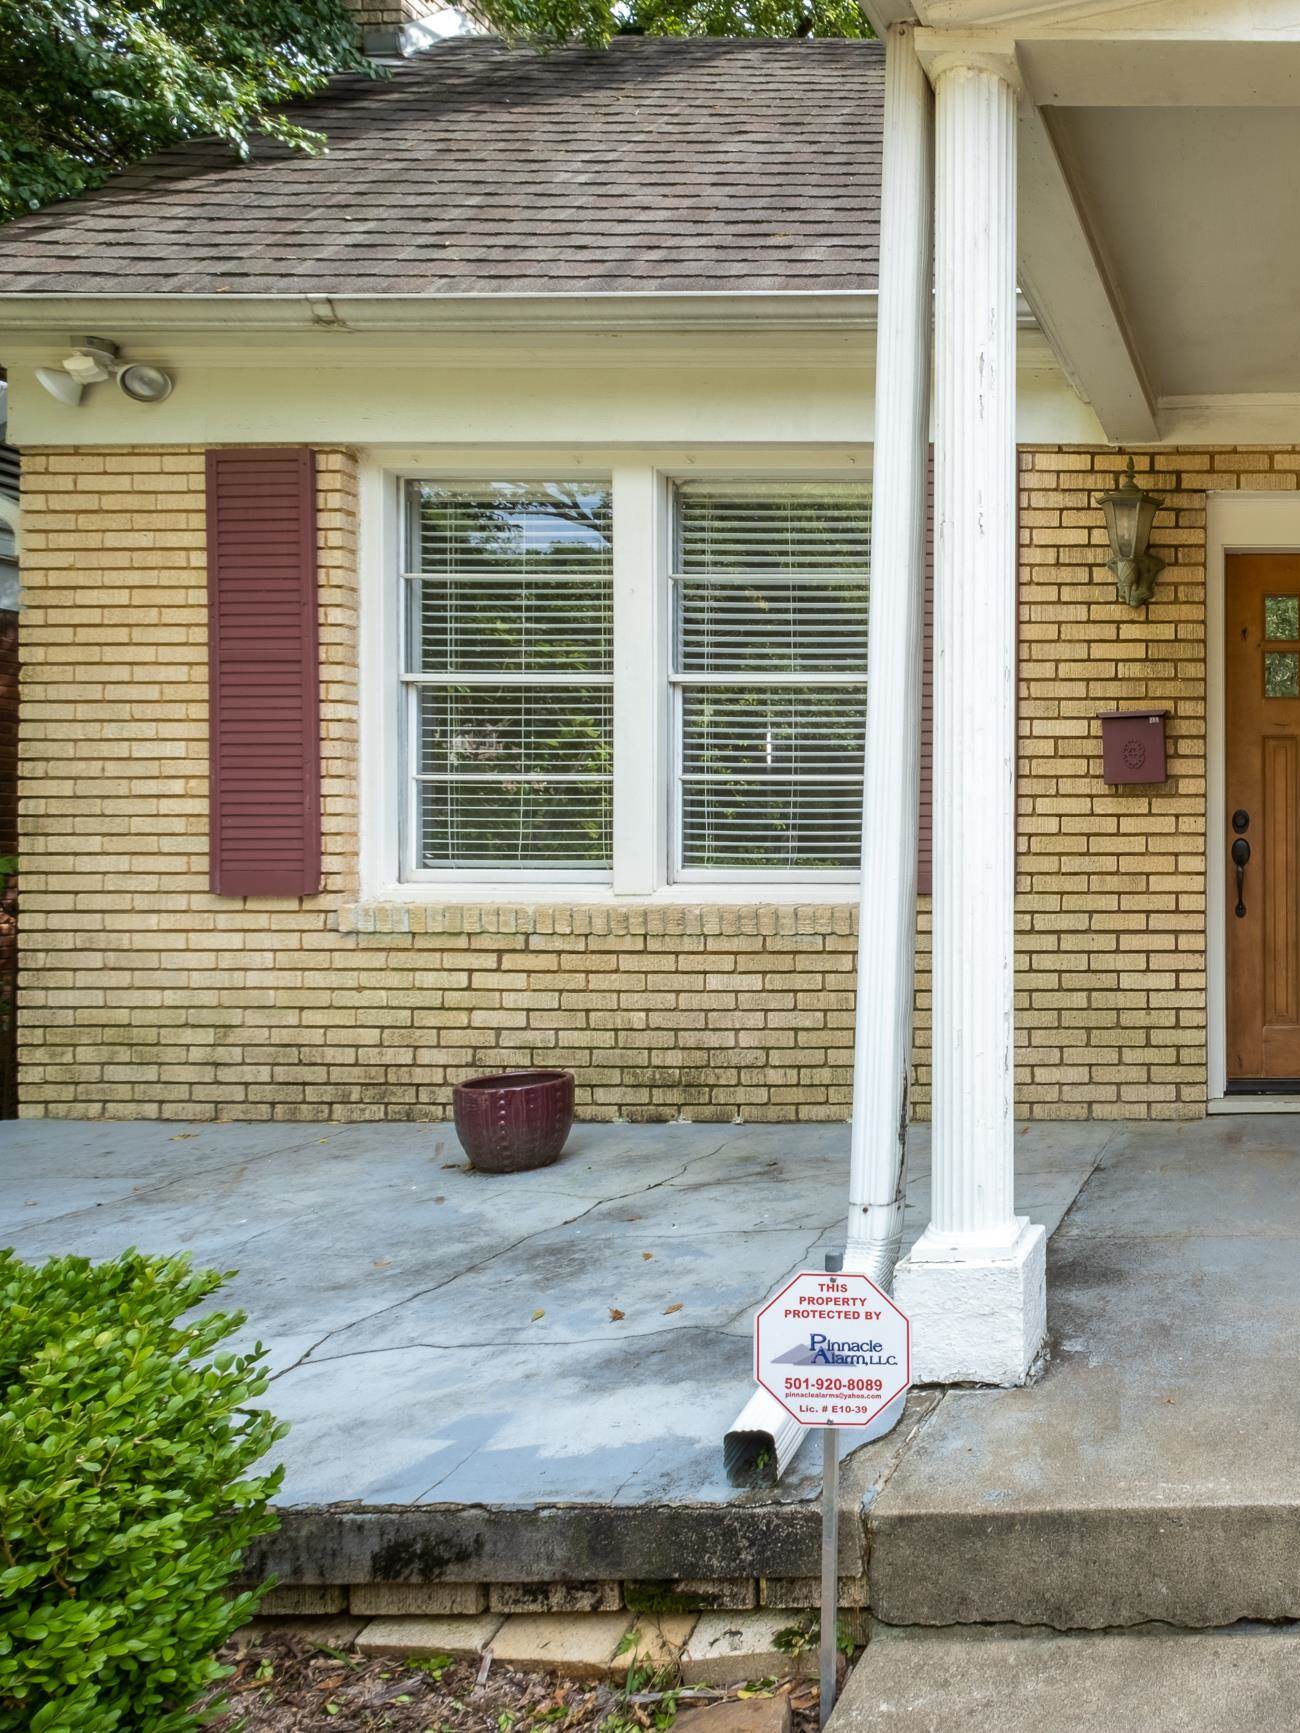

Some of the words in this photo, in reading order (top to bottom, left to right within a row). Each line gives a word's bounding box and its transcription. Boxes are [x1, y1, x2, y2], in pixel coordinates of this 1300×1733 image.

[818, 1284, 848, 1293] THIS
[799, 1297, 867, 1306] PROPERTY
[784, 1310, 861, 1320] PROTECTED
[865, 1311, 882, 1320] BY
[809, 1333, 883, 1352] Pinnacle
[784, 1378, 883, 1391] 501-920-8089
[799, 1405, 819, 1413] Lic.
[832, 1406, 868, 1414] E10-39
